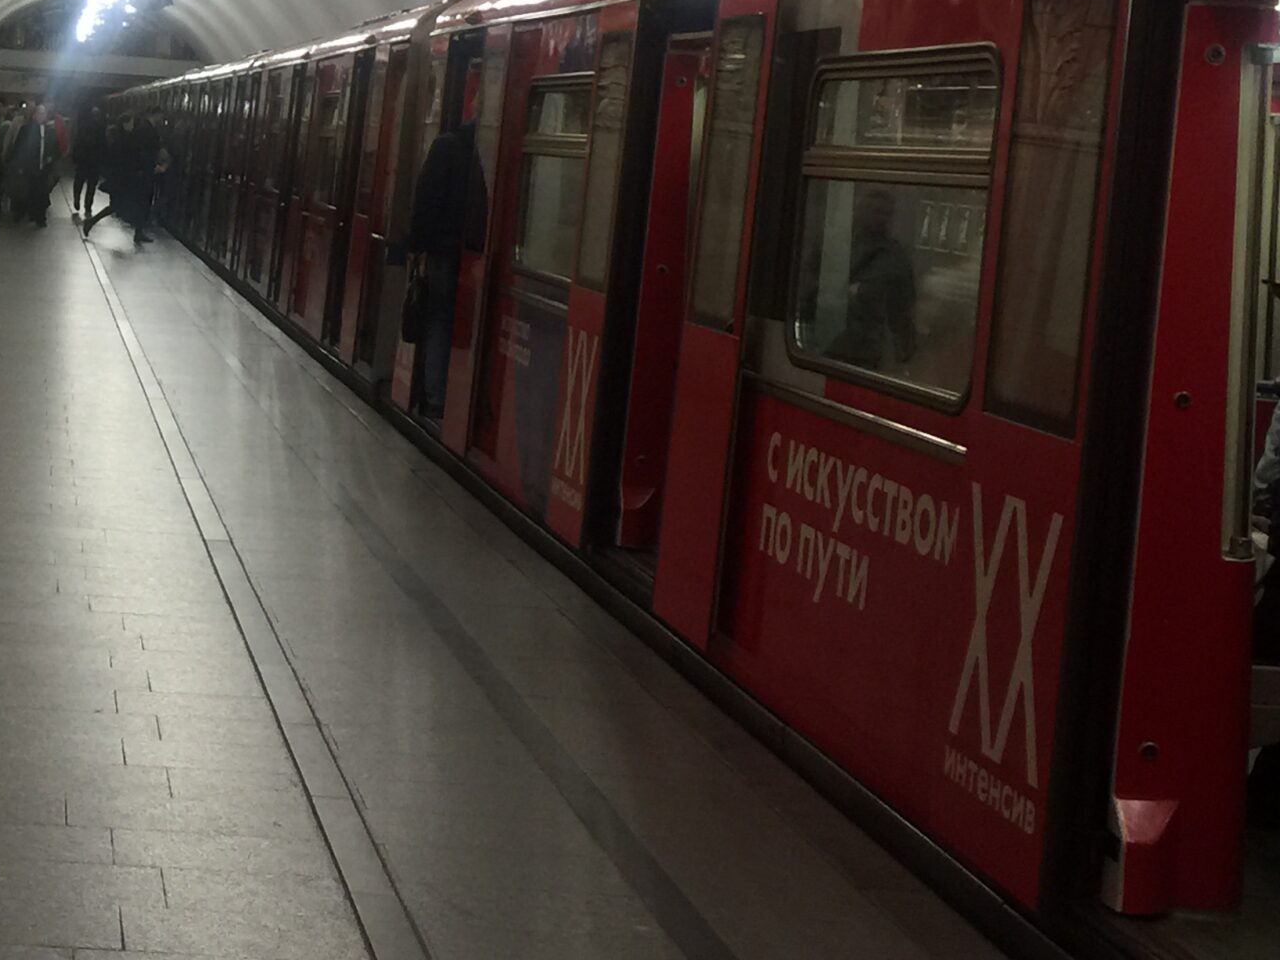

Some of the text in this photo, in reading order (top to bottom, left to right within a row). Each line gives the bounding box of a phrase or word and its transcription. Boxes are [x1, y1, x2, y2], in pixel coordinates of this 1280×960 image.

[767, 431, 782, 482] С
[759, 503, 870, 611] ПО ПУТИ
[948, 482, 1064, 789] XX
